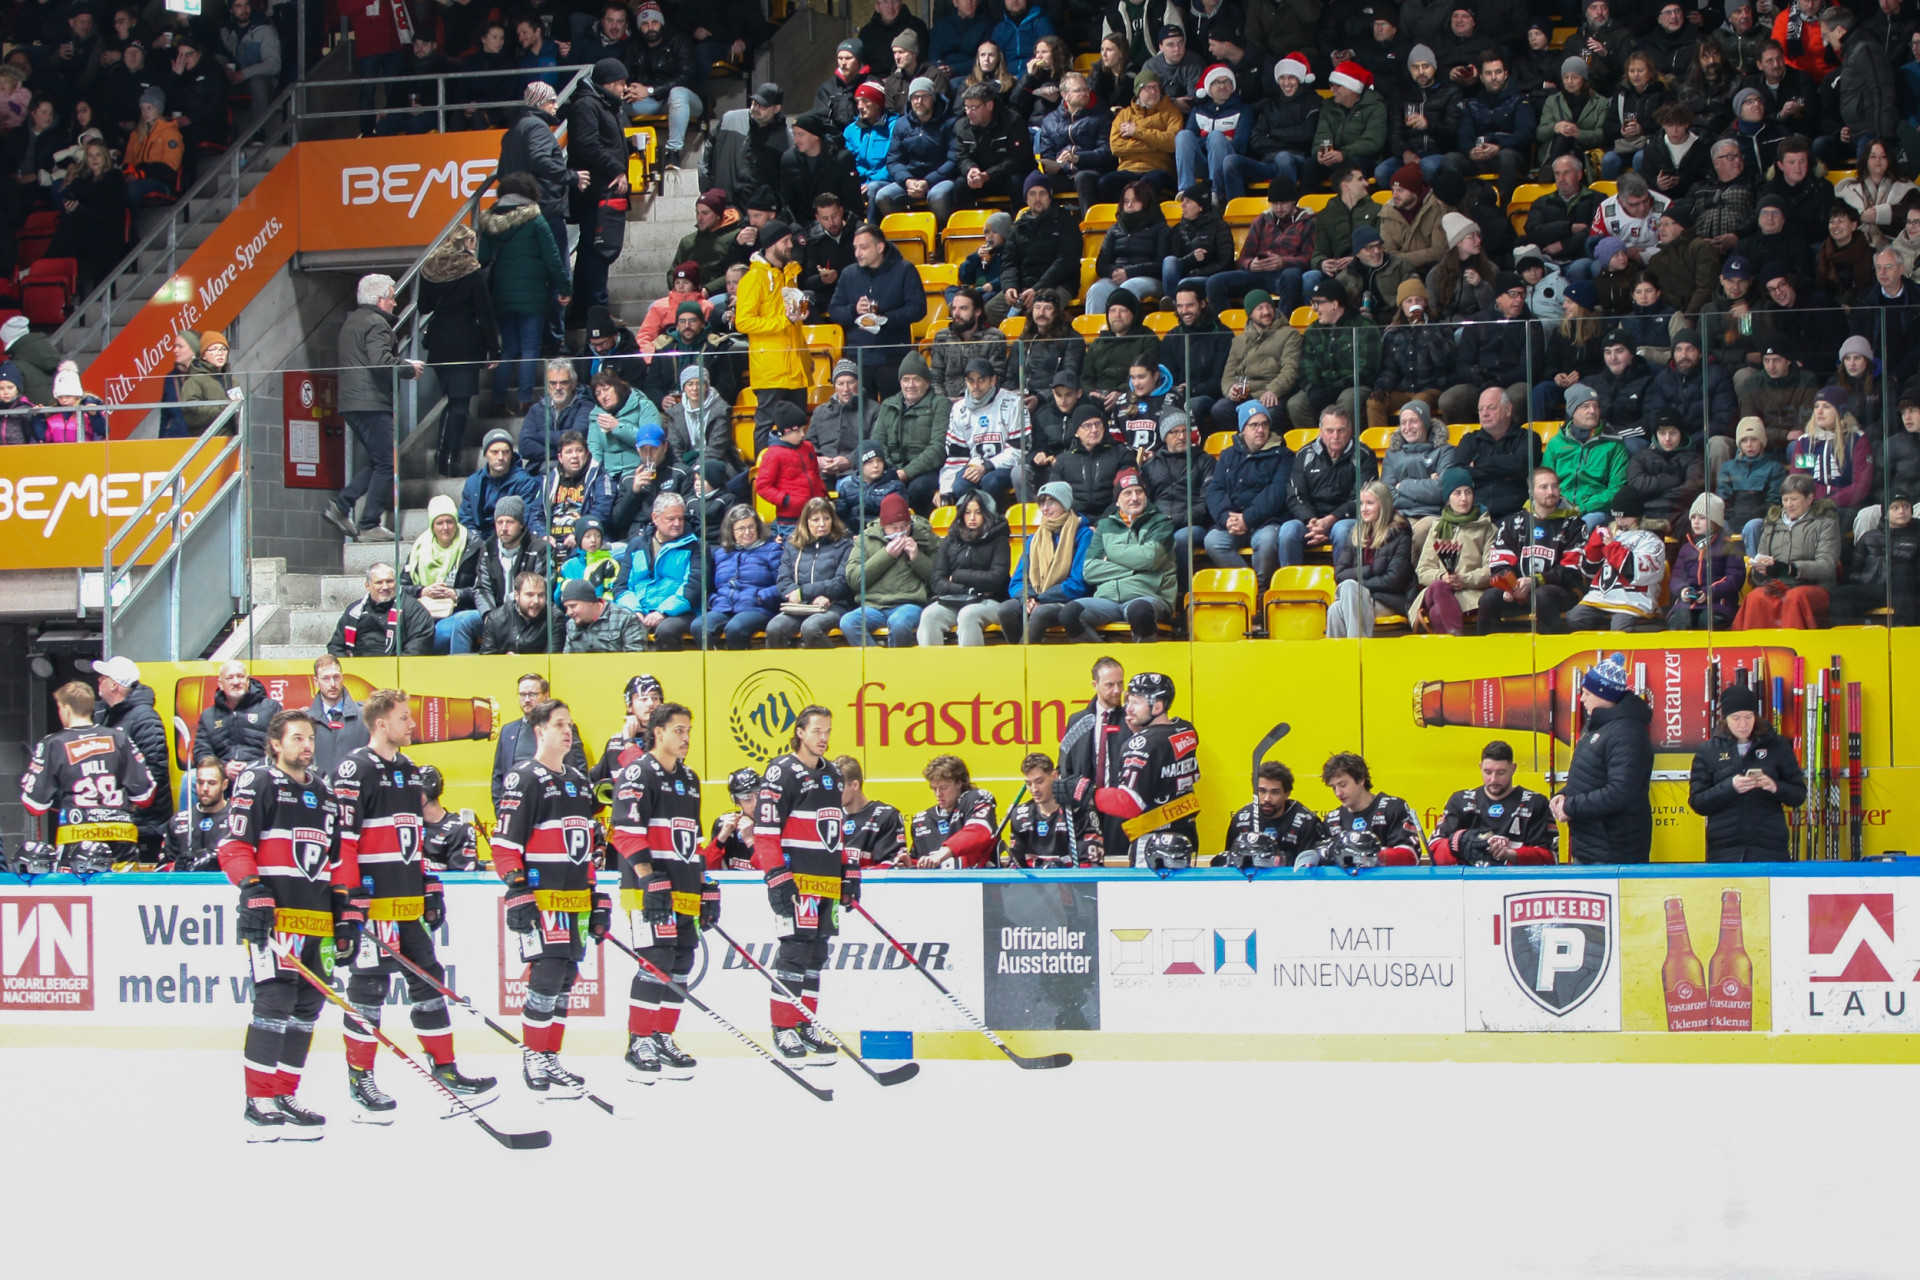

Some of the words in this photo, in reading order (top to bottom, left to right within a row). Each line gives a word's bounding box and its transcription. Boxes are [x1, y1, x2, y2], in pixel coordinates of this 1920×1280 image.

[342, 159, 499, 219] BEME
[134, 333, 174, 382] More
[170, 303, 203, 337] Life.
[199, 263, 239, 311] More
[235, 216, 284, 272] Sports.
[1661, 651, 1683, 749] frastanzer
[848, 682, 1091, 747] frastan
[81, 760, 109, 776] BULL
[73, 775, 124, 807] 28
[627, 802, 641, 823] 4
[1162, 796, 1200, 821] frasta
[71, 825, 135, 840] frastanzer
[325, 813, 335, 836] C
[1509, 817, 1521, 835] A
[570, 830, 585, 856] P
[304, 843, 321, 875] P
[798, 874, 842, 893] frastan
[274, 909, 334, 933] frastanze
[1513, 900, 1603, 919] PIONEERS
[138, 903, 224, 946] Weil
[1000, 926, 1086, 950] Offizieller
[1330, 927, 1394, 951] MATT
[997, 951, 1092, 976] Ausstatter
[1535, 927, 1586, 992] P
[3, 977, 89, 991] VORARLBERGER
[119, 963, 220, 1004] mehr
[1273, 963, 1454, 988] INNENAUSBAU
[3, 991, 81, 1004] NACHRICHTEN
[1667, 1000, 1708, 1013] frastanzer
[1709, 996, 1752, 1010] frastanzer
[1809, 990, 1906, 1017] LAU
